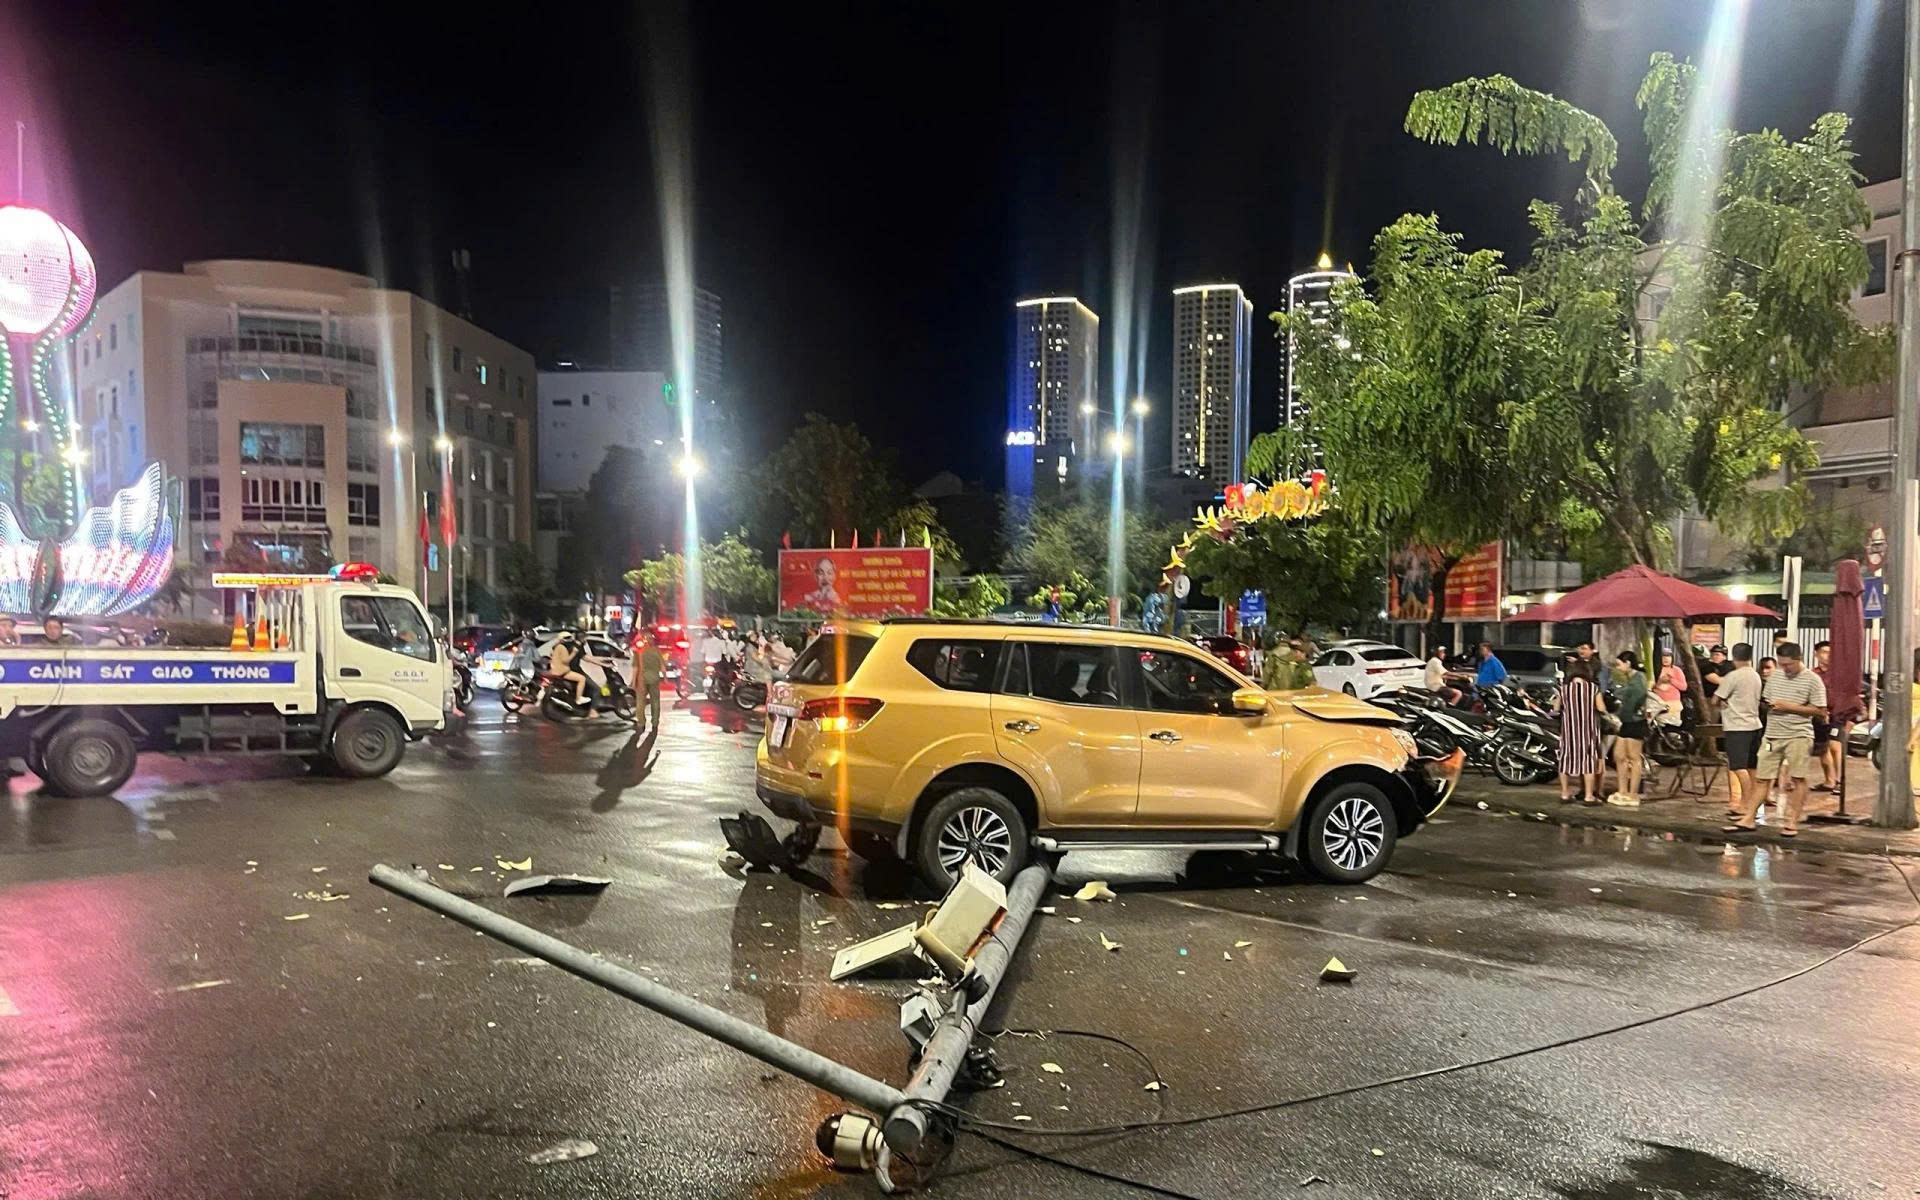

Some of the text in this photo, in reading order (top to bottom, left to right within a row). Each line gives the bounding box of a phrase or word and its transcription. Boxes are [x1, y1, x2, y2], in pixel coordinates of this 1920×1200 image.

[100, 664, 135, 679] SÁT
[152, 666, 194, 679] GIAO
[211, 665, 270, 679] THÔNG
